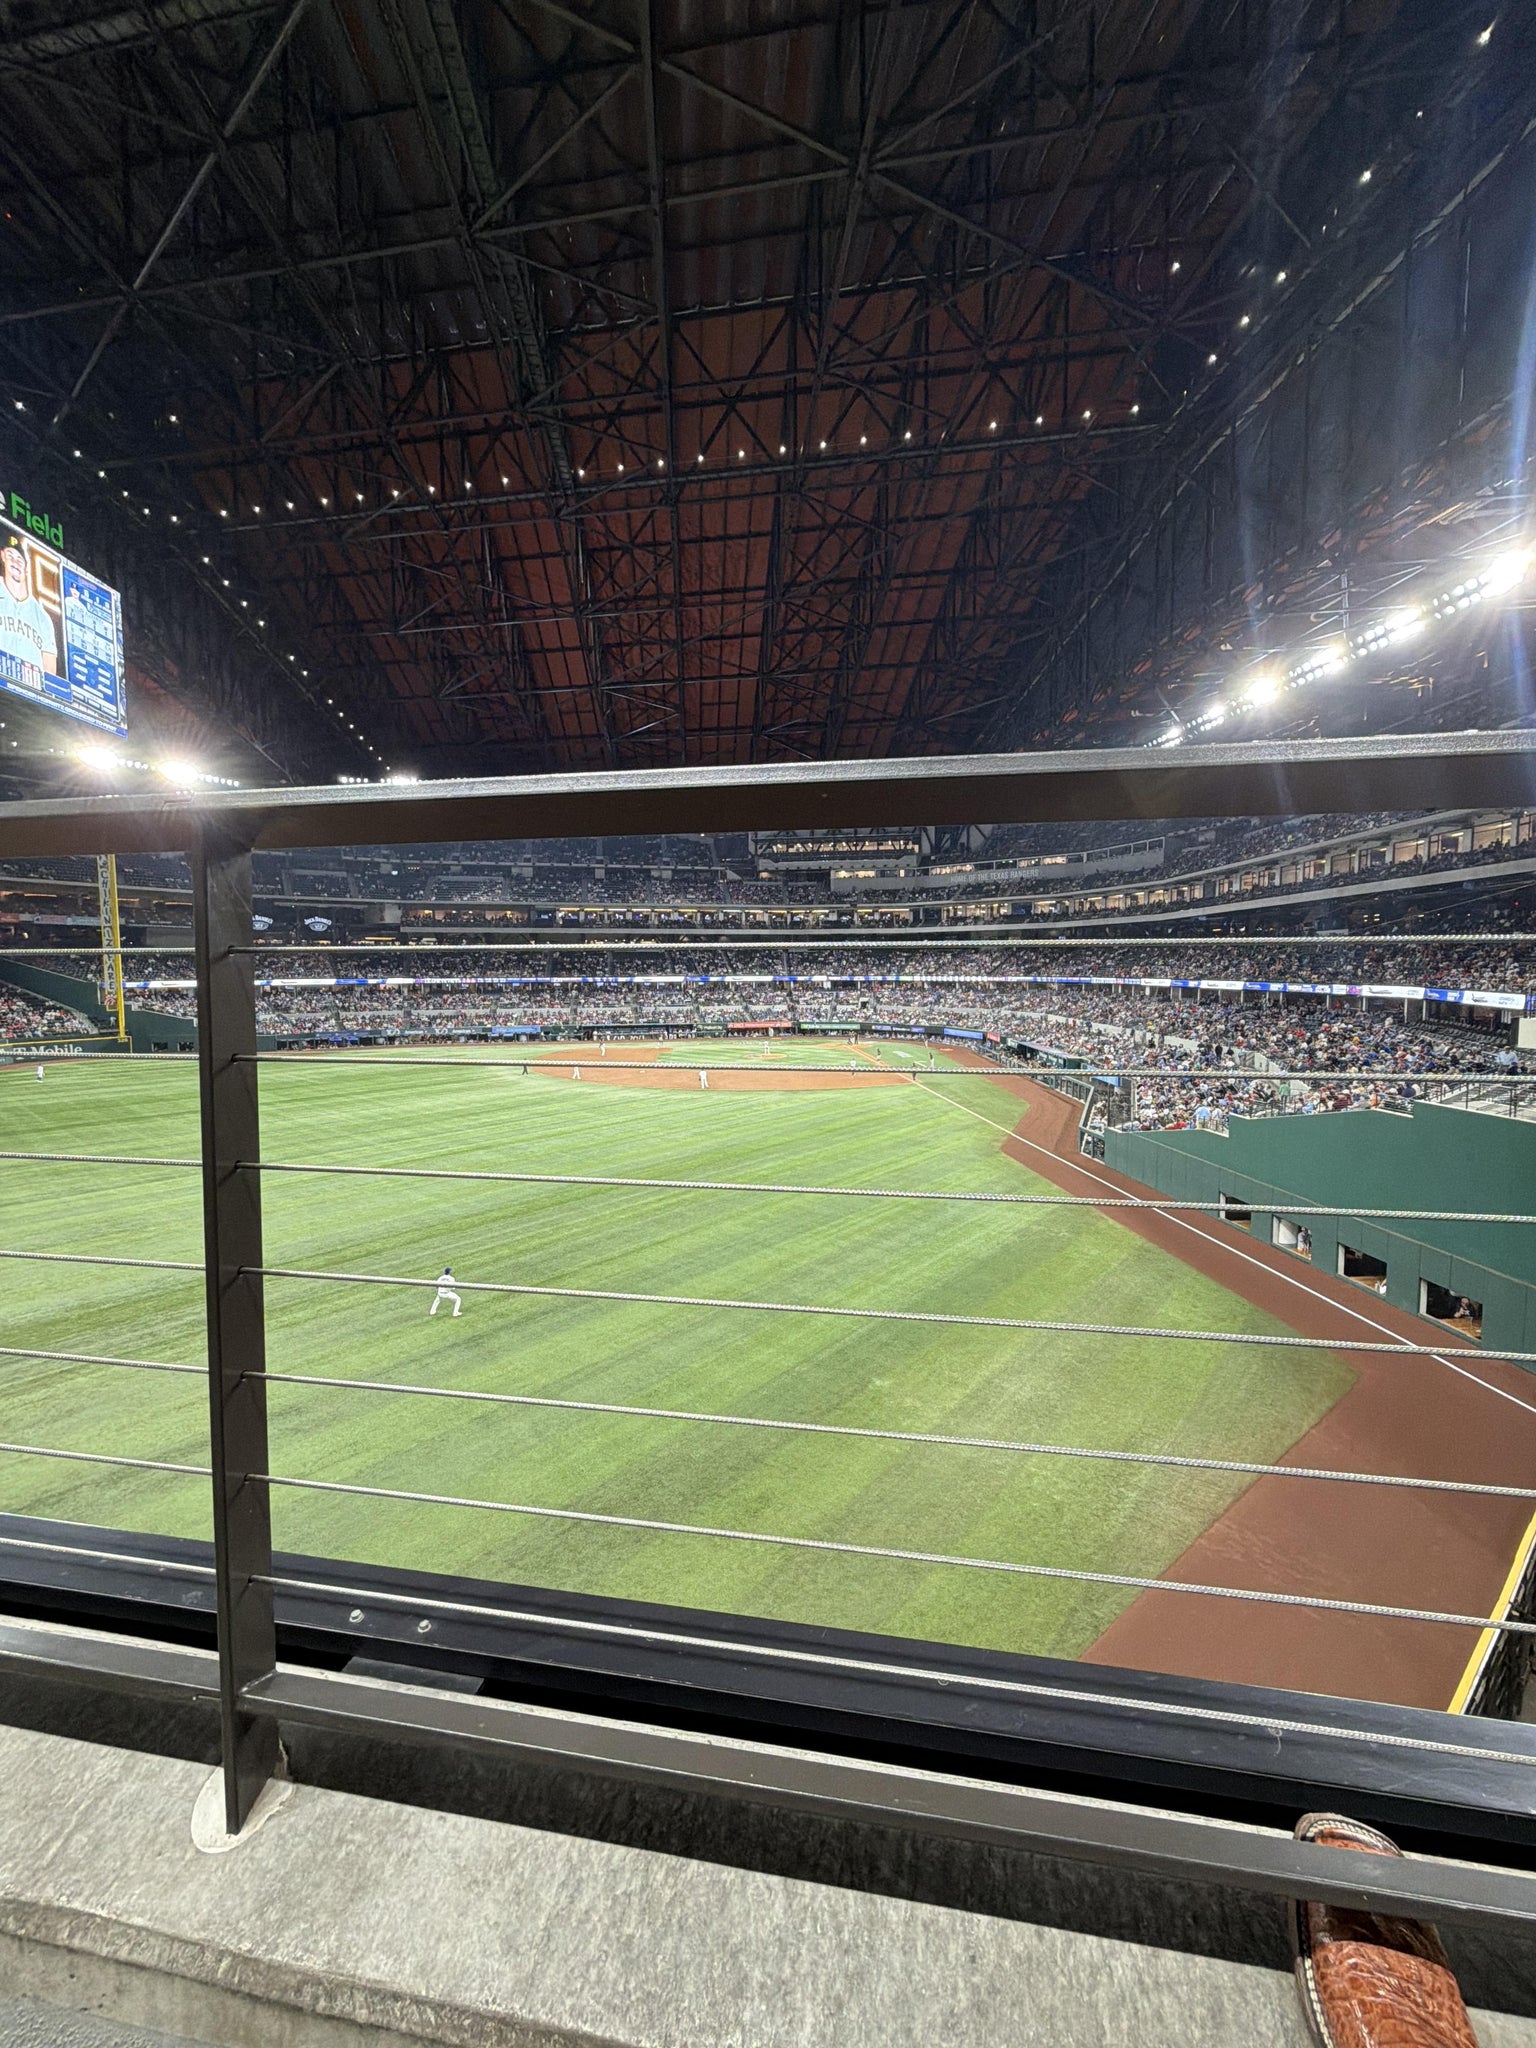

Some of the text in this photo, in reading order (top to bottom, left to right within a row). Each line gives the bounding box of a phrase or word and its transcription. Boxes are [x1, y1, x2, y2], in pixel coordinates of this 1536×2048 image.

[11, 491, 64, 550] Field
[951, 869, 1039, 883] HOME OF THE TEXAS RANGERS
